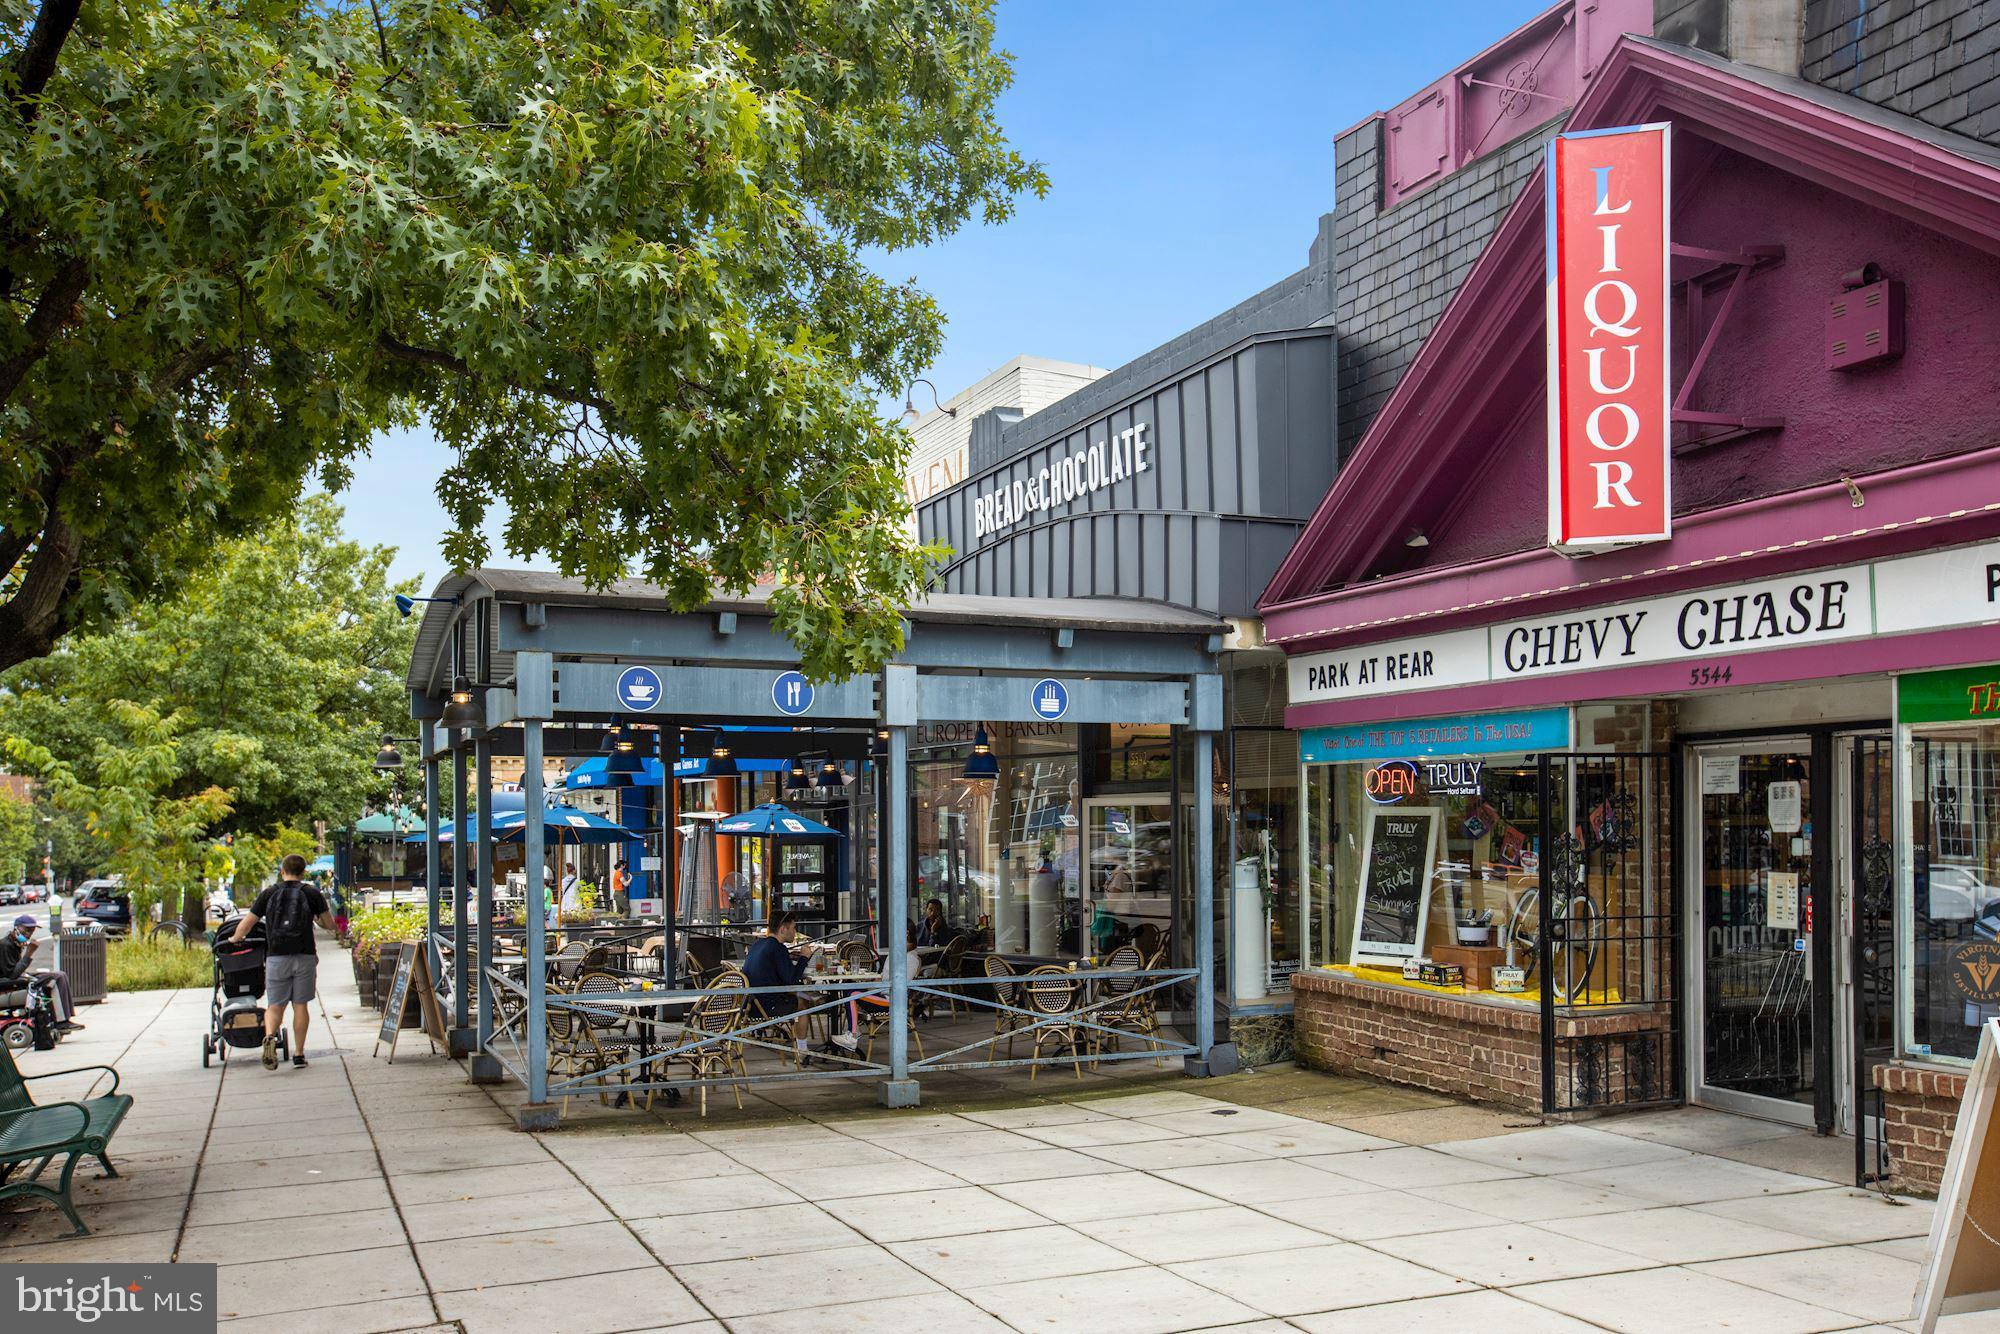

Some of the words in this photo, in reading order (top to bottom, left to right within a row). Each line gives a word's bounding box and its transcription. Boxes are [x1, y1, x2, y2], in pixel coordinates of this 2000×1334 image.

[1583, 166, 1642, 510] LIQUOR
[1504, 611, 1647, 672] CHEVY
[1677, 580, 1849, 650] CHASE
[1309, 662, 1349, 690] PARK
[1358, 657, 1378, 685] AT
[1386, 650, 1434, 681] REAR
[1689, 665, 1733, 686] 5544
[917, 722, 997, 744] EUROPEN
[1368, 730, 1386, 747] THE
[1418, 726, 1468, 744] RETAILERS
[1485, 724, 1502, 741] The
[1504, 722, 1533, 739] USA!
[1365, 768, 1414, 794] OPEN
[1426, 761, 1481, 785] TRULY
[1459, 787, 1476, 795] Seltzer
[1387, 822, 1418, 834] TRULY
